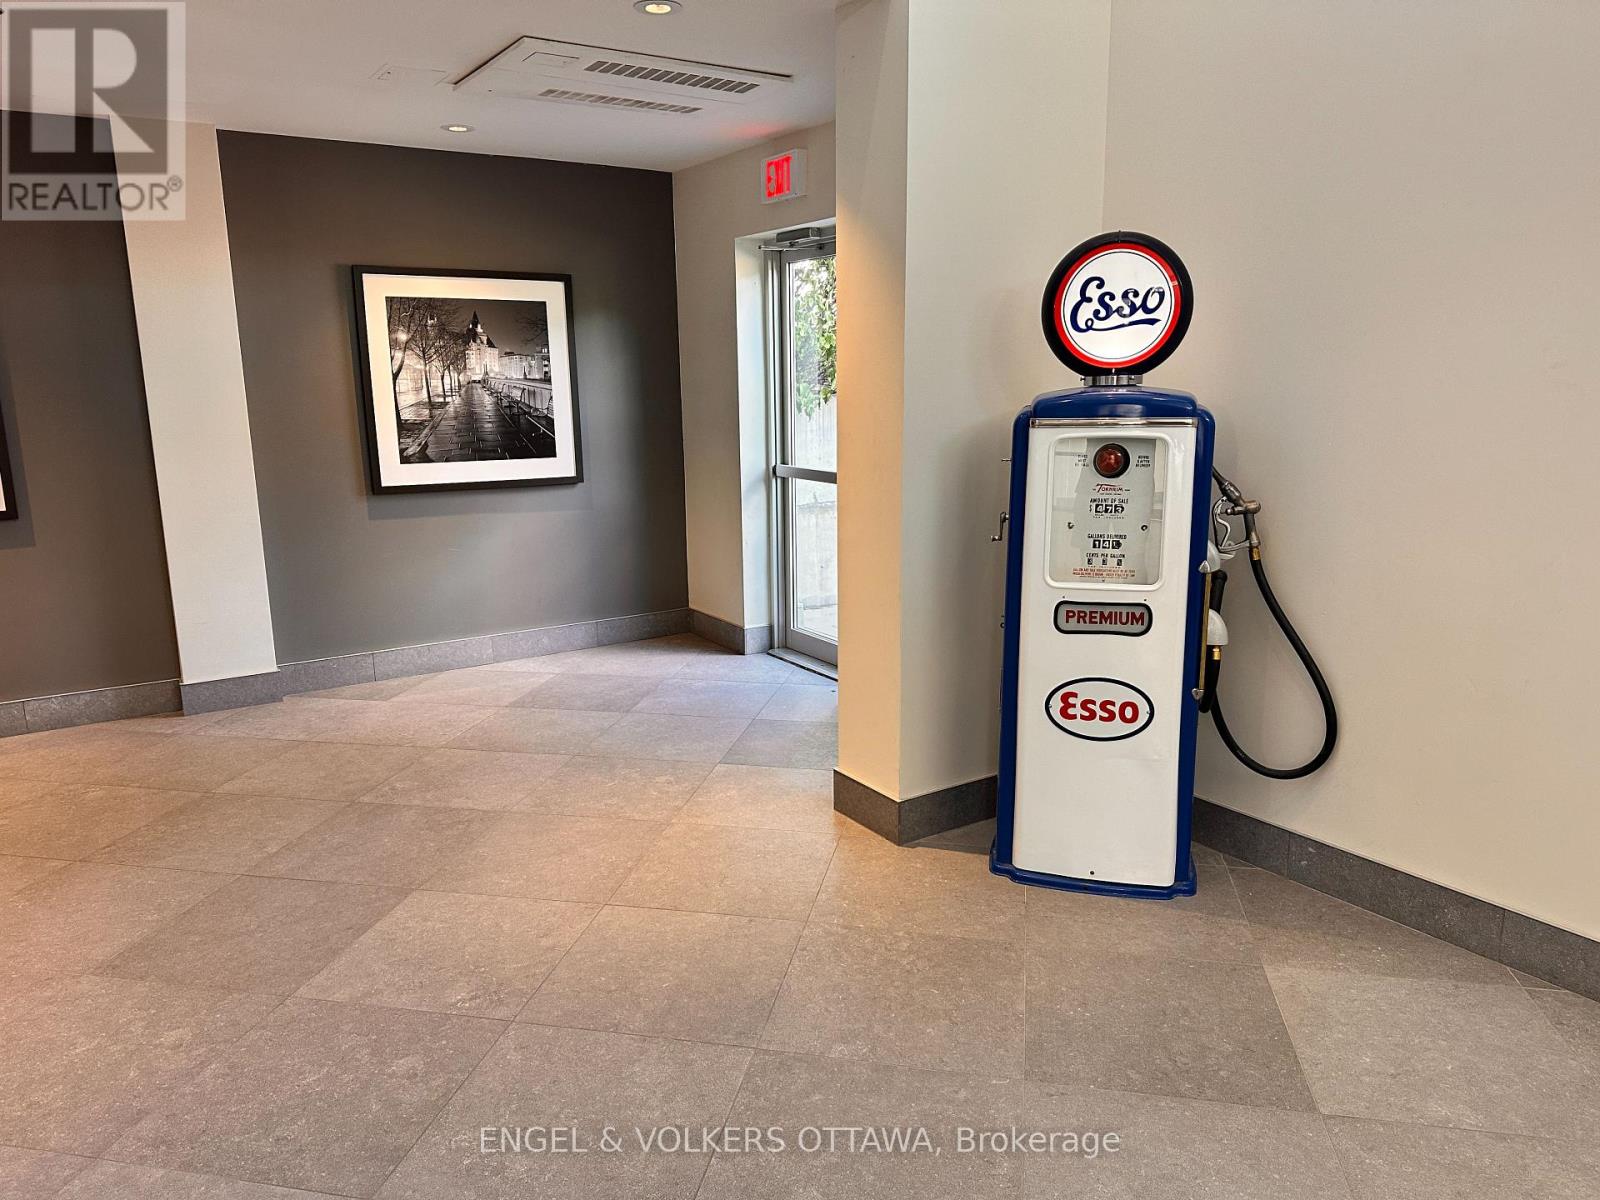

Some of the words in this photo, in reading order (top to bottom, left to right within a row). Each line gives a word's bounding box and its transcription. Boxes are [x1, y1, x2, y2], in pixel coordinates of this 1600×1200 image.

[763, 152, 785, 188] EXIT
[1069, 275, 1166, 334] Esso
[1065, 609, 1145, 626] PREMIUM
[1059, 690, 1139, 724] Esso
